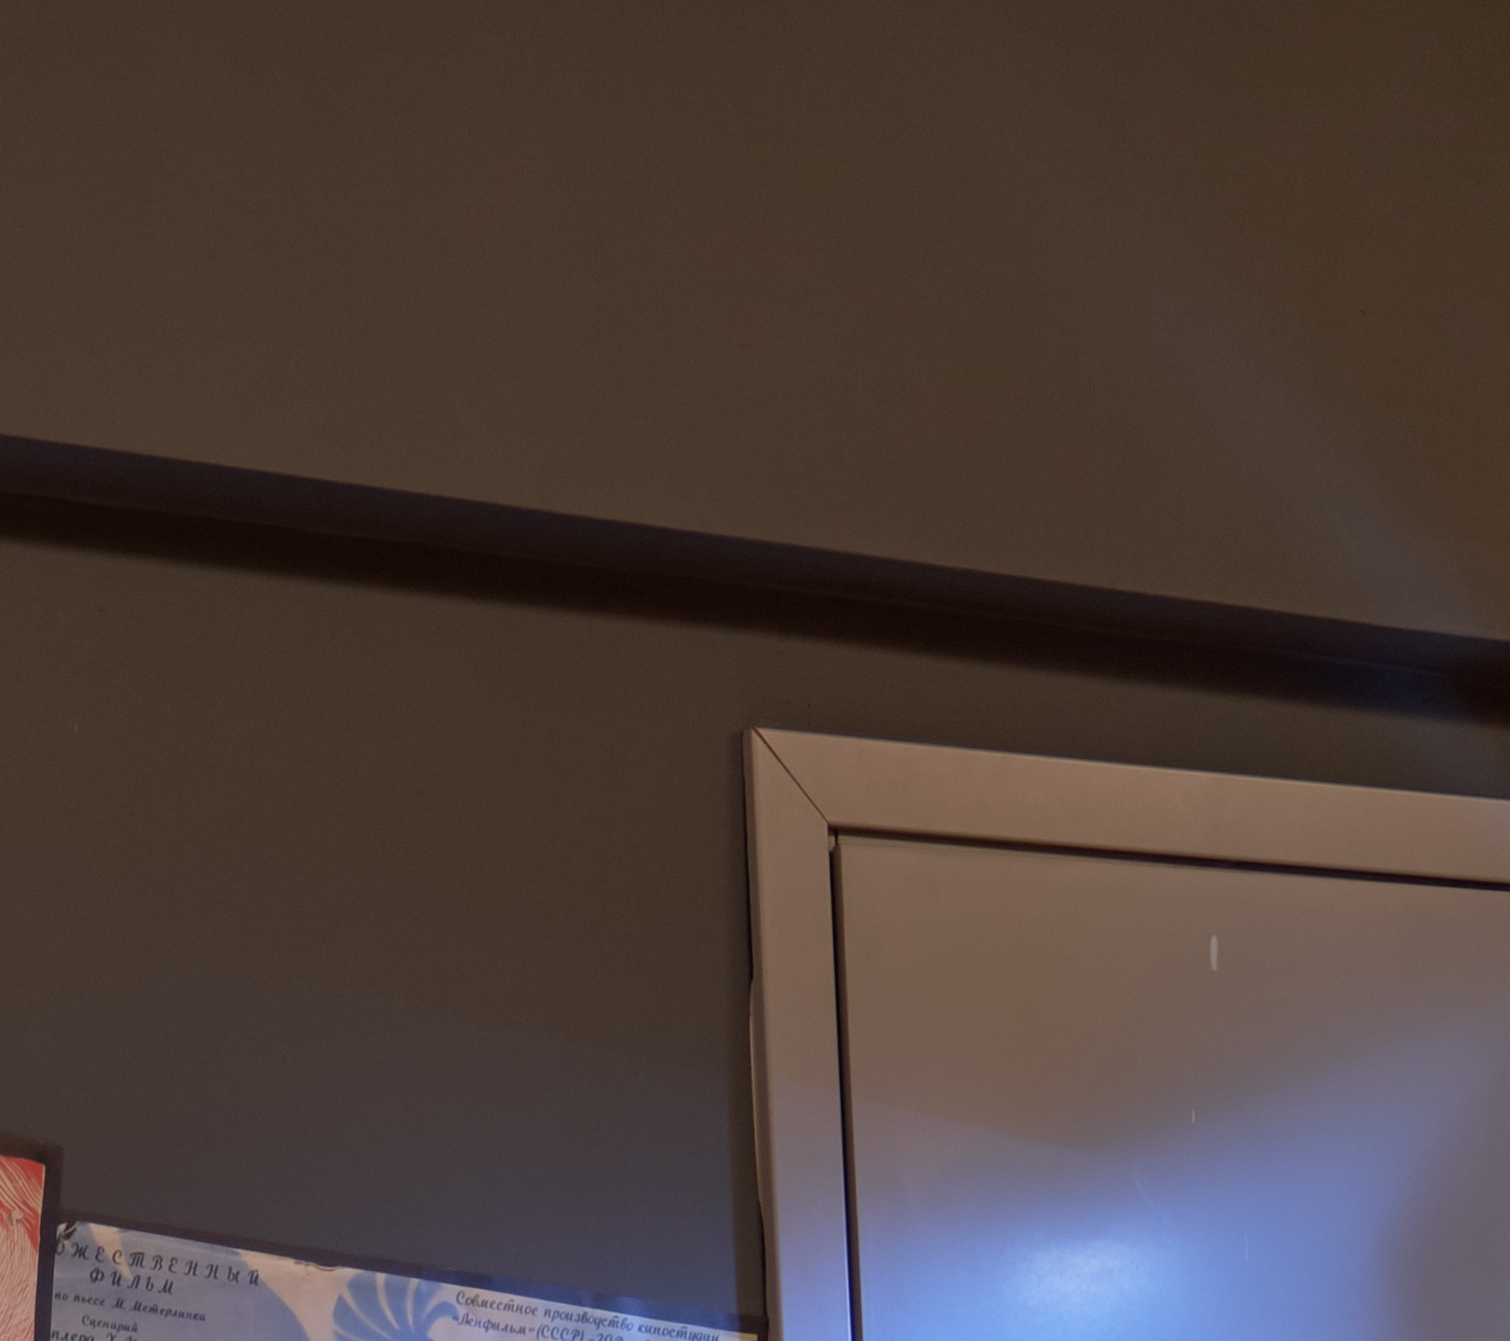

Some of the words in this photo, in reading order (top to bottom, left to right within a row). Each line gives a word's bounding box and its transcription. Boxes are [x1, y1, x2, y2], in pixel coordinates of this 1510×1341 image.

[89, 1267, 173, 1295] ФИЛЬМ
[129, 1301, 206, 1322] Метерлинка
[456, 1290, 539, 1316] Совместное
[543, 1306, 634, 1332] производство
[81, 1315, 138, 1333] Сценарий
